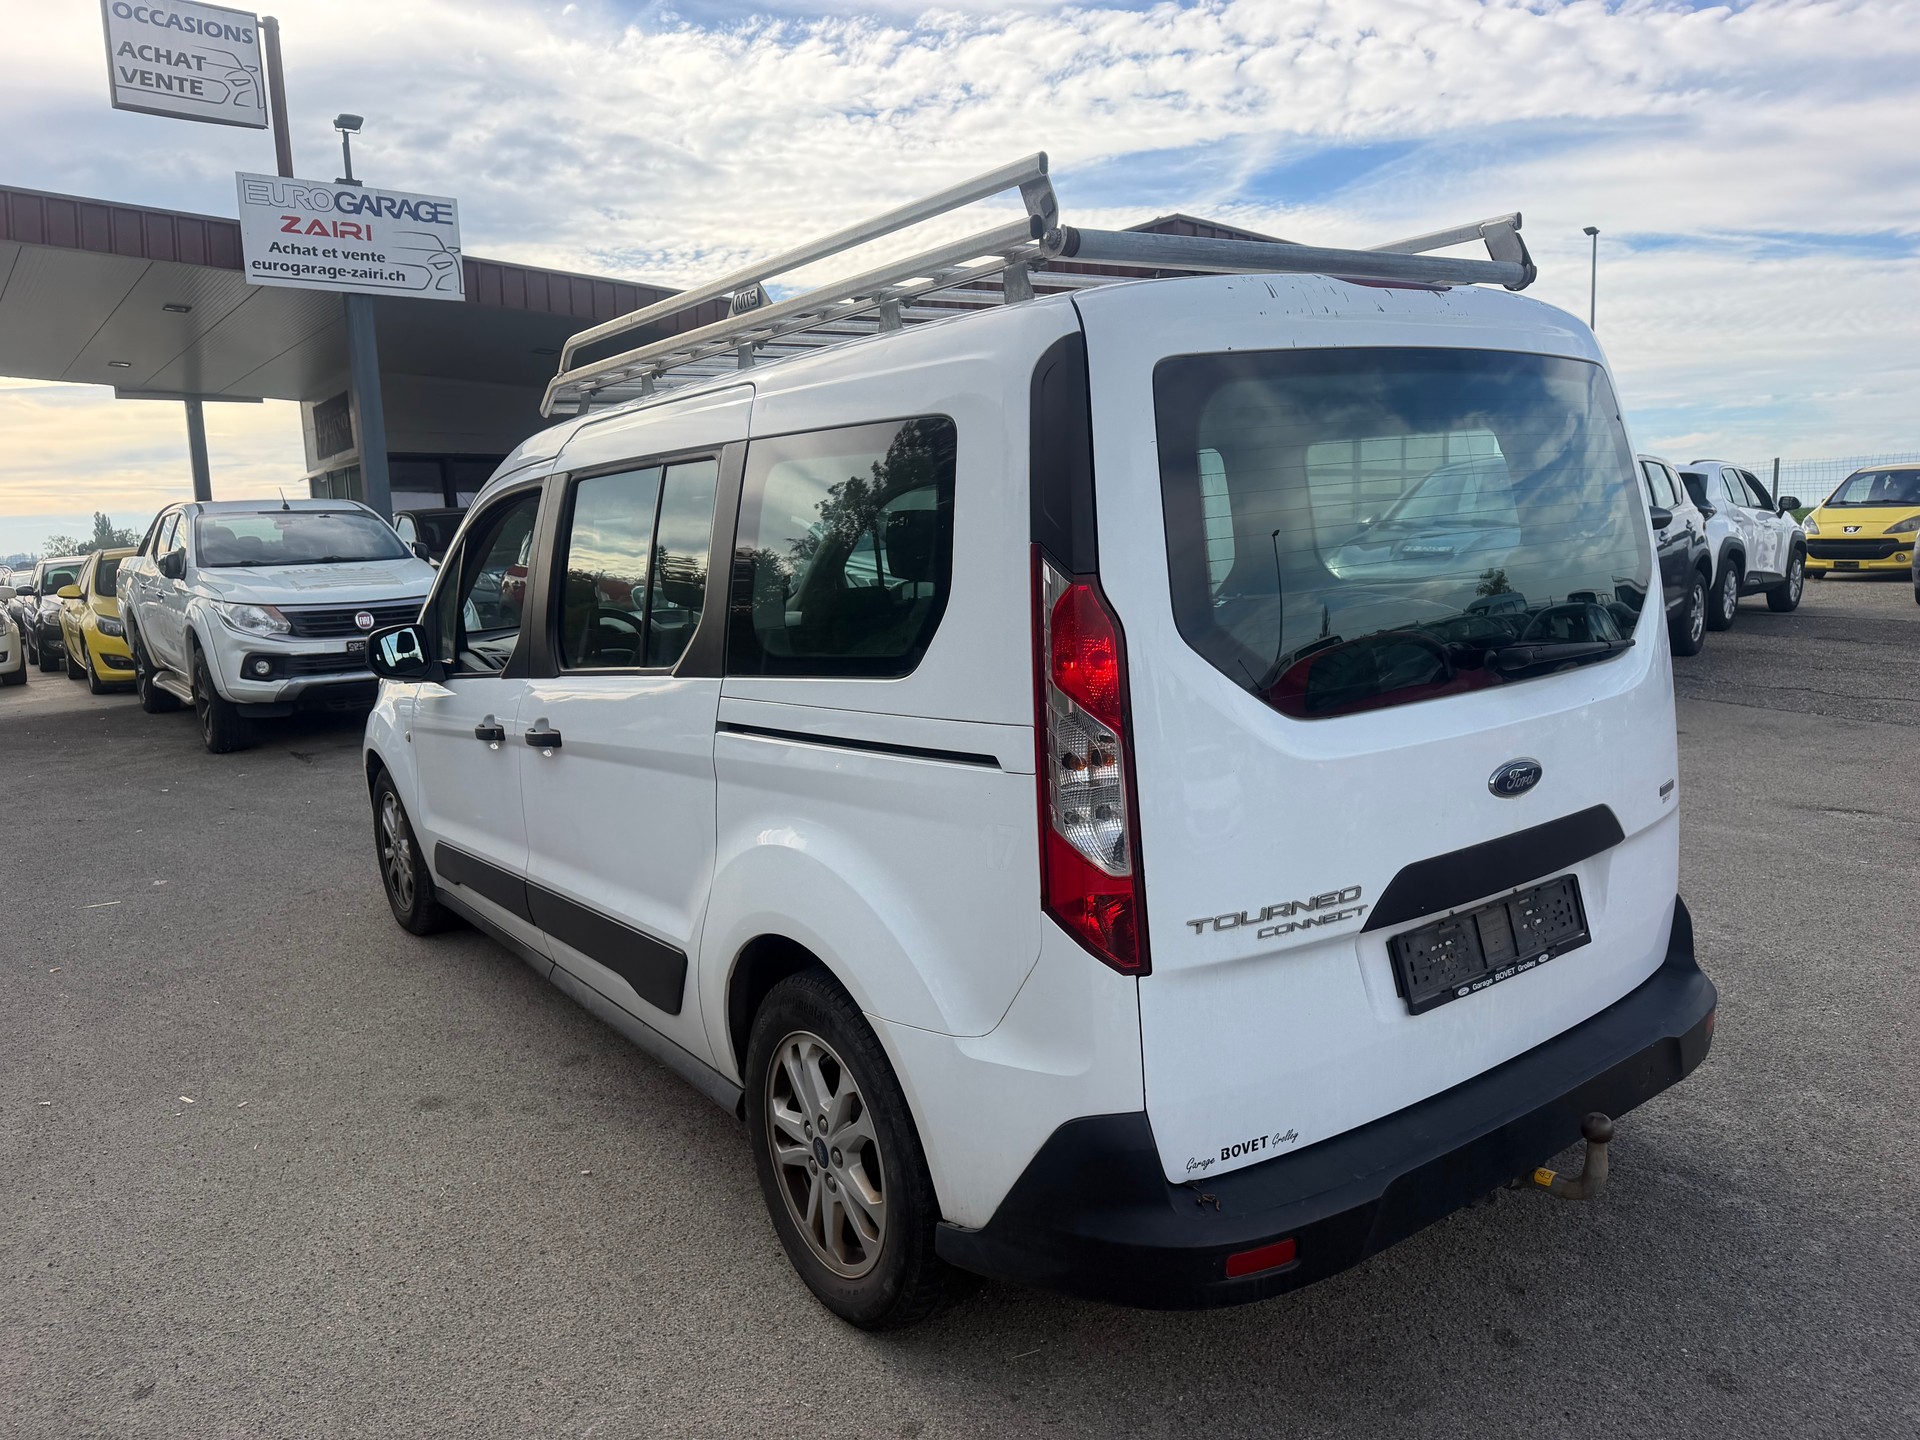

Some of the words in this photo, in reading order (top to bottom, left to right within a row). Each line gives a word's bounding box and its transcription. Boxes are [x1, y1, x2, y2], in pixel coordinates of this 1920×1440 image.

[112, 2, 254, 44] OCCASIONS
[117, 41, 206, 71] ACHAT
[119, 66, 204, 96] VENTE
[243, 179, 453, 225] EUROGARAGE
[280, 215, 372, 241] ZAIRI
[269, 241, 318, 257] Achat
[322, 247, 338, 258] et
[341, 251, 386, 263] vente
[252, 259, 406, 282] eurogarage-zairi.ch
[735, 289, 757, 311] MTS
[1507, 767, 1535, 790] Ford
[1186, 884, 1362, 935] TOURNEO
[1257, 904, 1369, 939] CONNECT
[1472, 977, 1493, 990] Garage
[1495, 967, 1516, 981] BOVET
[1517, 960, 1536, 972] Grolley
[1186, 1157, 1215, 1173] Garage
[1221, 1135, 1268, 1161] BOVET
[1272, 1128, 1299, 1148] Grolley
